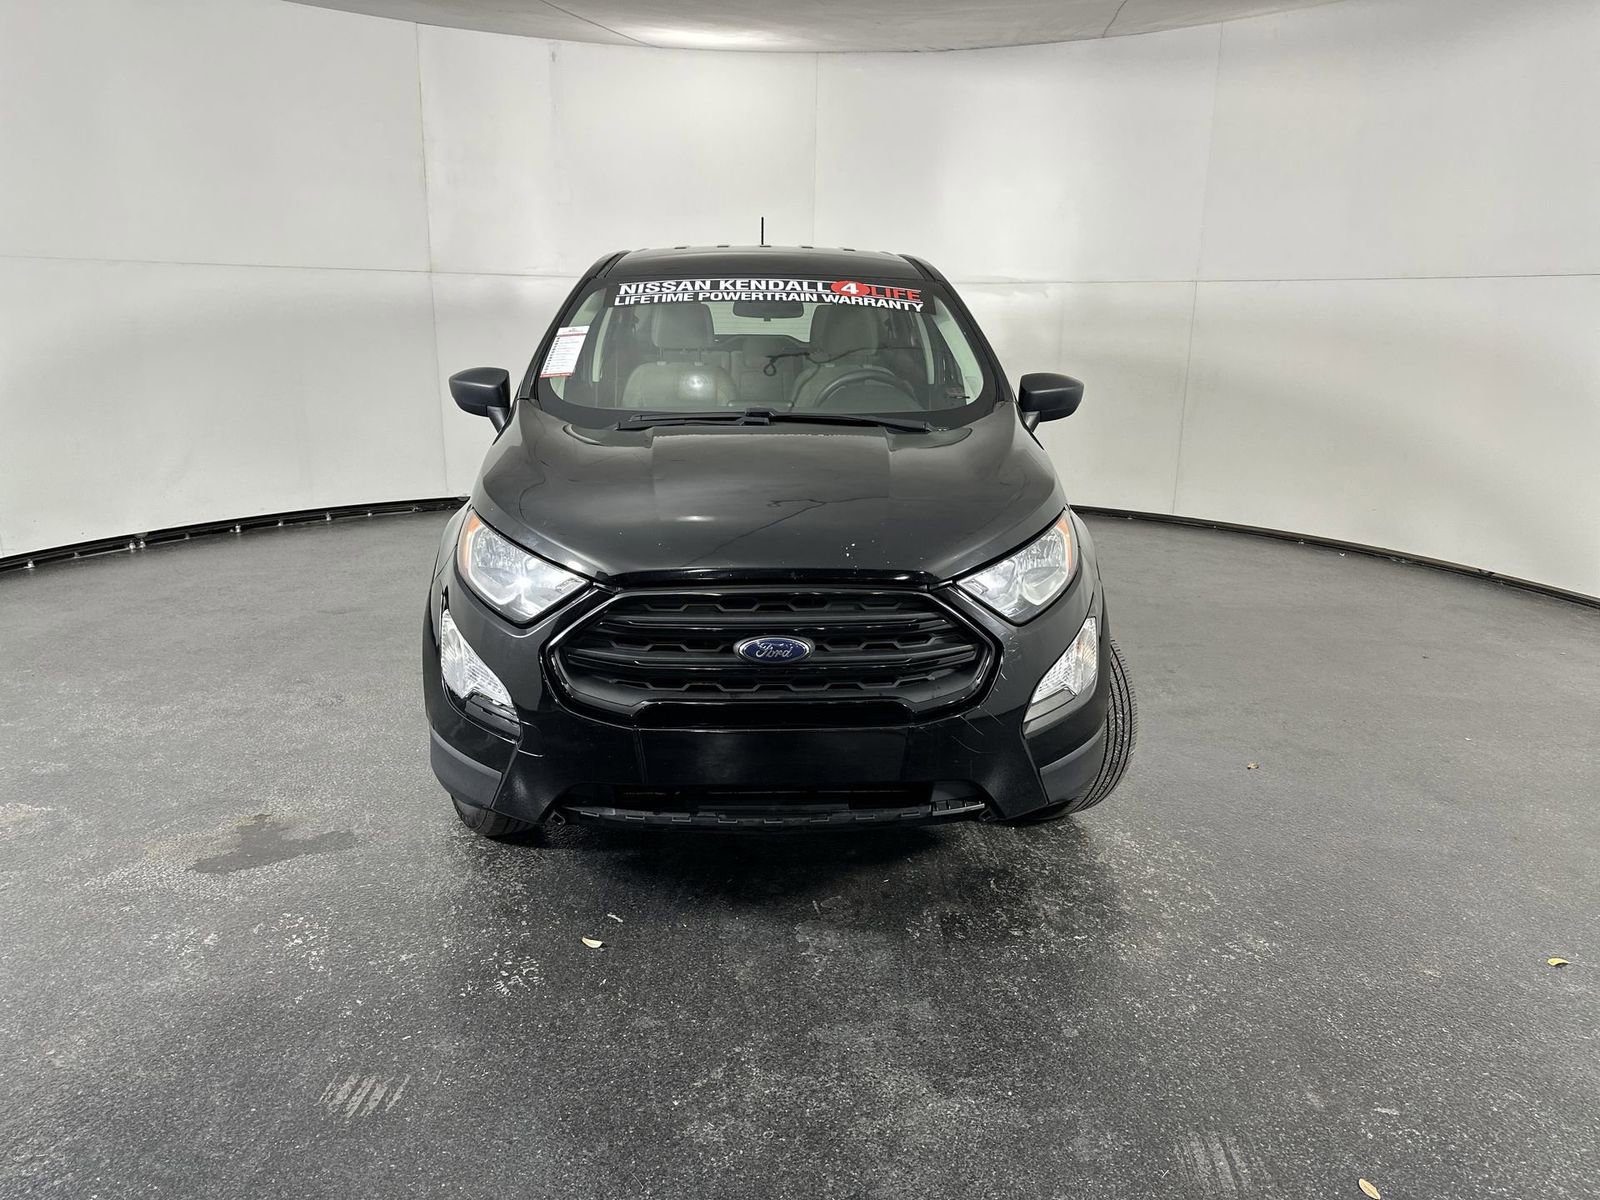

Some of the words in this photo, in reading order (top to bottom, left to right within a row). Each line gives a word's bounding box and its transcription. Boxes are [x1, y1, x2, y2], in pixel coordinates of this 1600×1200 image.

[619, 280, 710, 295] NISSAN
[719, 280, 831, 293] KENDALL
[840, 283, 859, 294] 4
[870, 287, 920, 299] LIFE
[614, 293, 694, 306] LIFETIME
[698, 292, 817, 301] POWERTRAIN
[822, 294, 923, 311] WARRANTY
[755, 642, 794, 658] Ford
